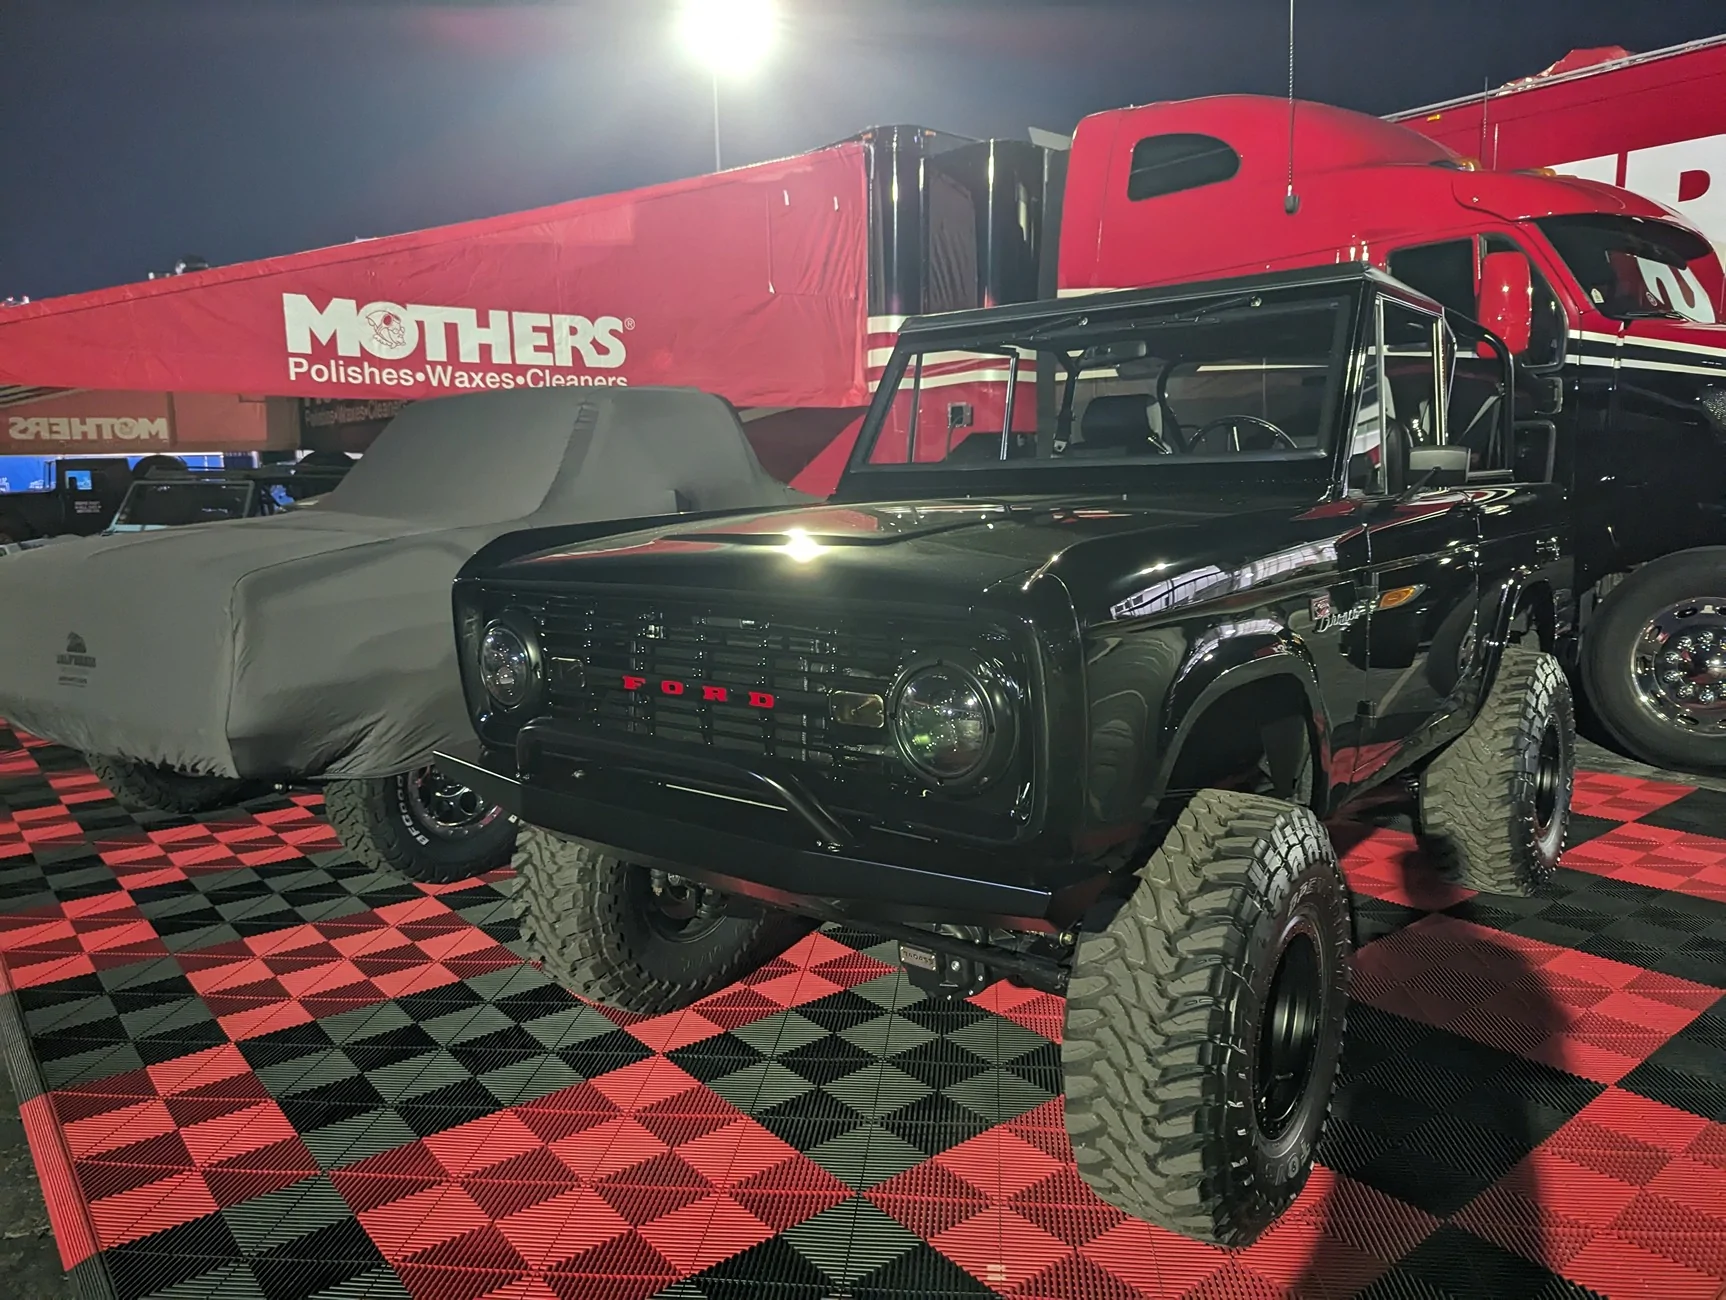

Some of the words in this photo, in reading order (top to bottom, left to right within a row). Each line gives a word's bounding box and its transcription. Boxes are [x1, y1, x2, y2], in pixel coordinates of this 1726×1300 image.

[282, 293, 626, 368] MOTHERS
[288, 358, 415, 387] Polishes
[425, 365, 515, 390] Waxes
[622, 675, 775, 709] FORD
